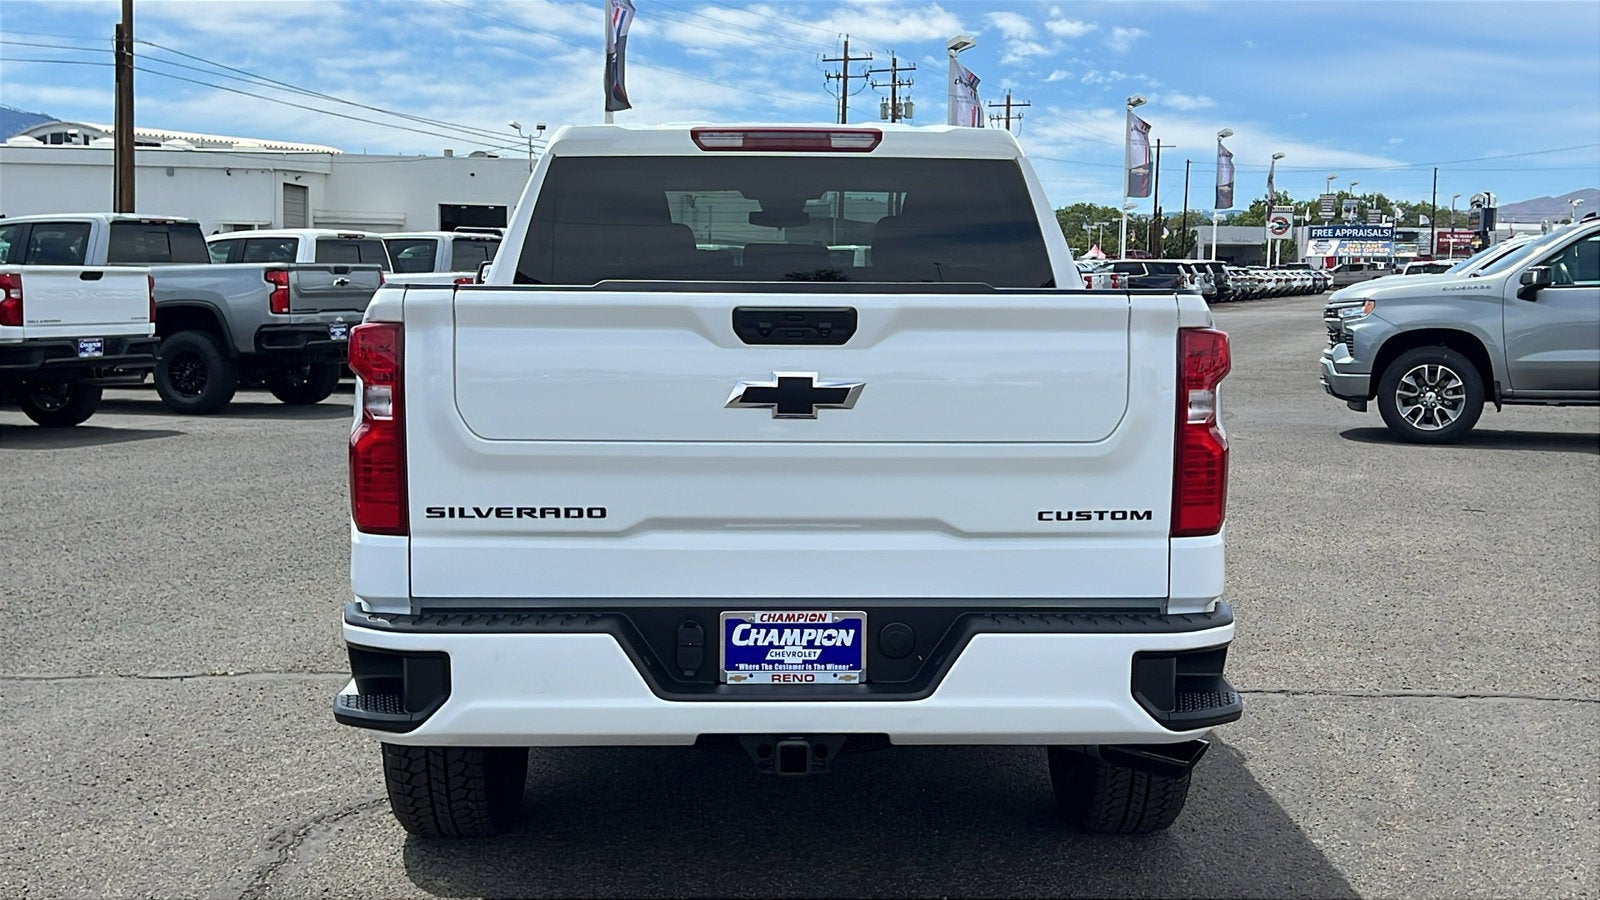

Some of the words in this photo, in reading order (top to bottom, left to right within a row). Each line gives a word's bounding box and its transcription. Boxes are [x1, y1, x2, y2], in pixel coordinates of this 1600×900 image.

[1312, 229, 1333, 237] FREE
[1335, 229, 1392, 237] APPRAISALS!
[425, 507, 607, 519] SILVERADO
[1037, 510, 1153, 521] CUSTOM
[760, 613, 827, 622] CHAMPION
[731, 623, 855, 646] CHAMPION
[769, 650, 817, 658] CHEVROLET
[771, 674, 815, 682] RENO
